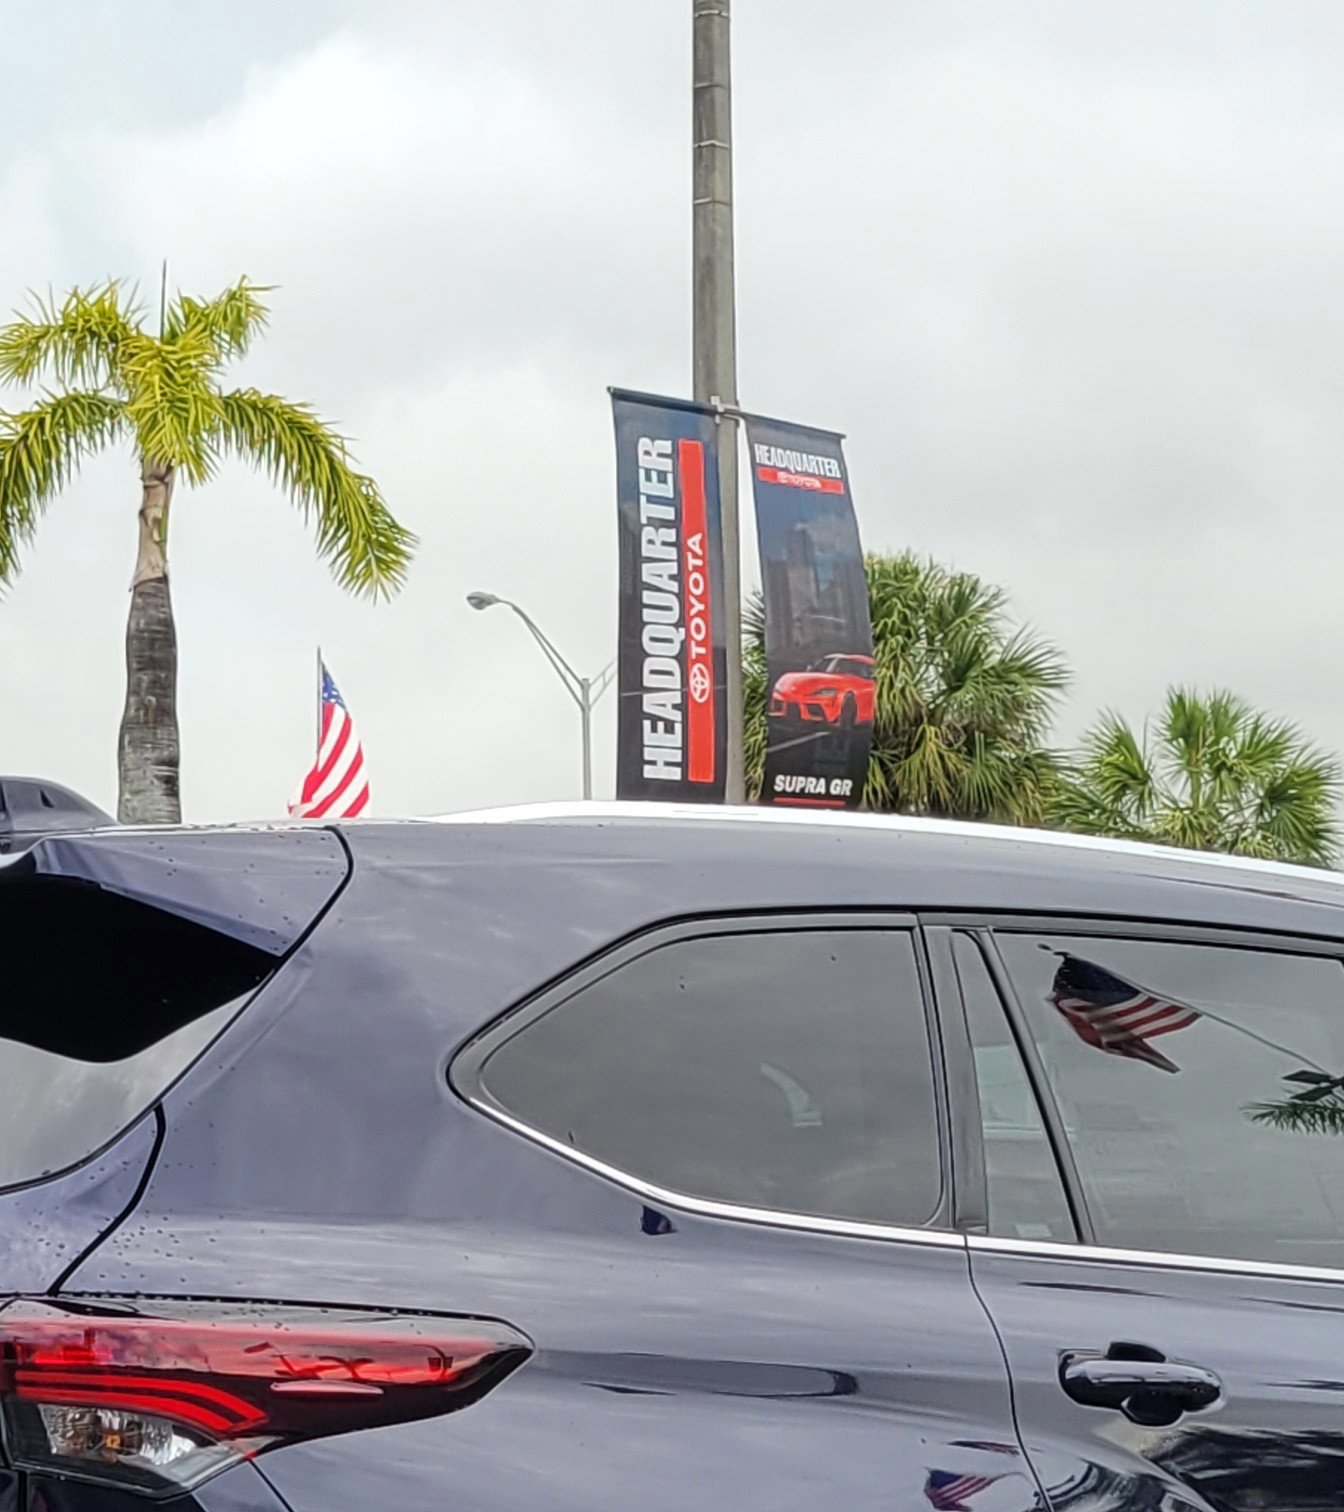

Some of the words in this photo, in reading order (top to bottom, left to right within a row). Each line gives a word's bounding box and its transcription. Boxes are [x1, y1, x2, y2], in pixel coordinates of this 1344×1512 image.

[753, 443, 842, 478] HEADQUARTER
[637, 436, 685, 781] HEADQUARTER
[686, 533, 707, 659] TOYOTA
[773, 775, 827, 795] SUPRA
[829, 779, 853, 796] GR
